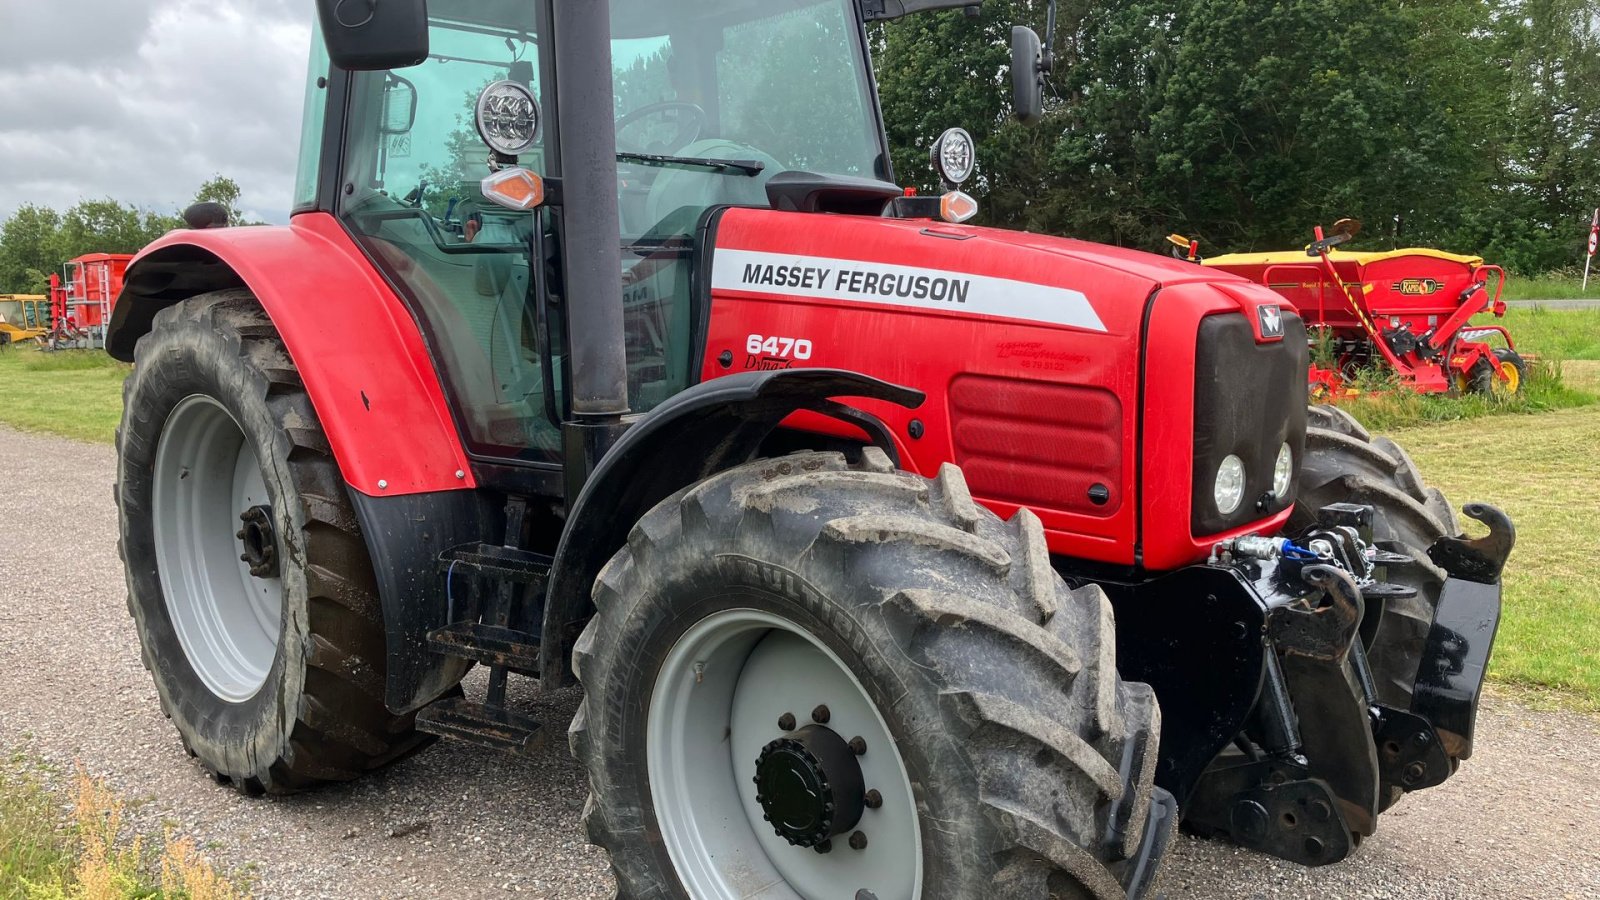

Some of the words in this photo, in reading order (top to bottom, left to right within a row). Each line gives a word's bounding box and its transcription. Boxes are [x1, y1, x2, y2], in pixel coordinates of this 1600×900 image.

[742, 263, 831, 290] MASSEY
[835, 269, 971, 303] FERGUSON
[746, 334, 813, 360] 6470
